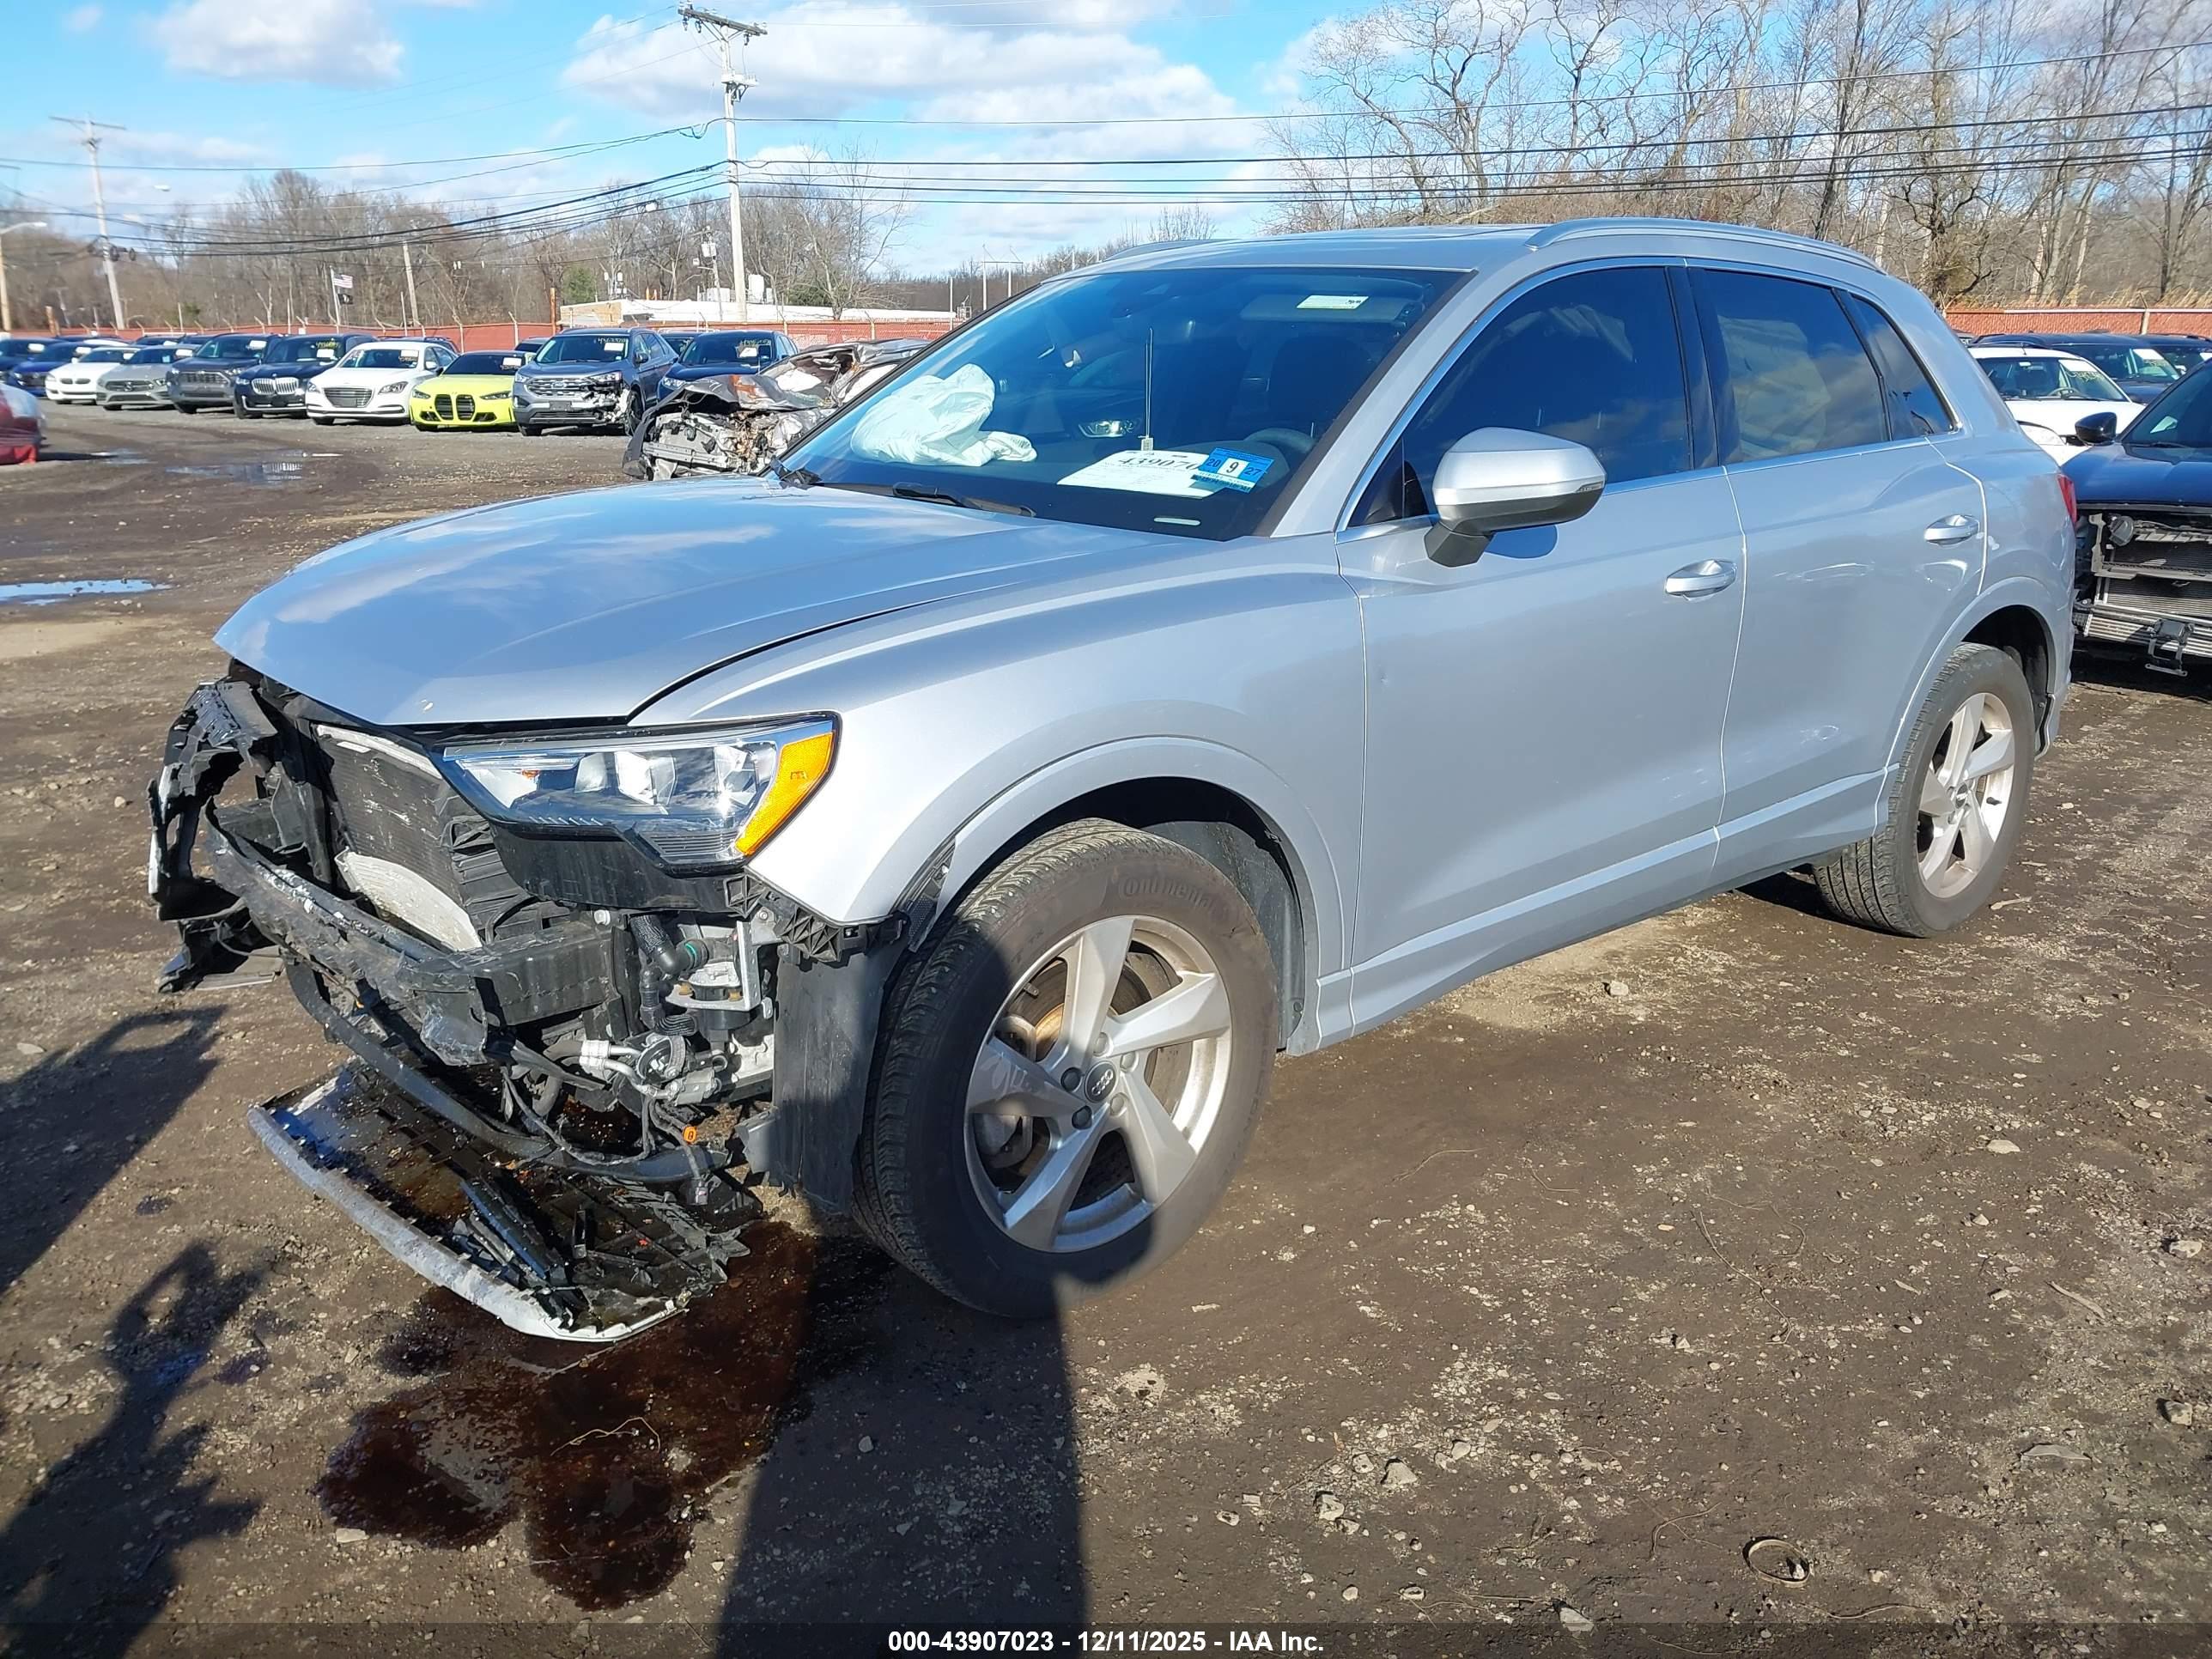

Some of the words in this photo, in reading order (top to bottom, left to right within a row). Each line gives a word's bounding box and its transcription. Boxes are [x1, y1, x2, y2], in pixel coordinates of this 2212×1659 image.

[1206, 458, 1222, 468] 20
[1225, 461, 1239, 474] 9
[1243, 466, 1262, 476] 27
